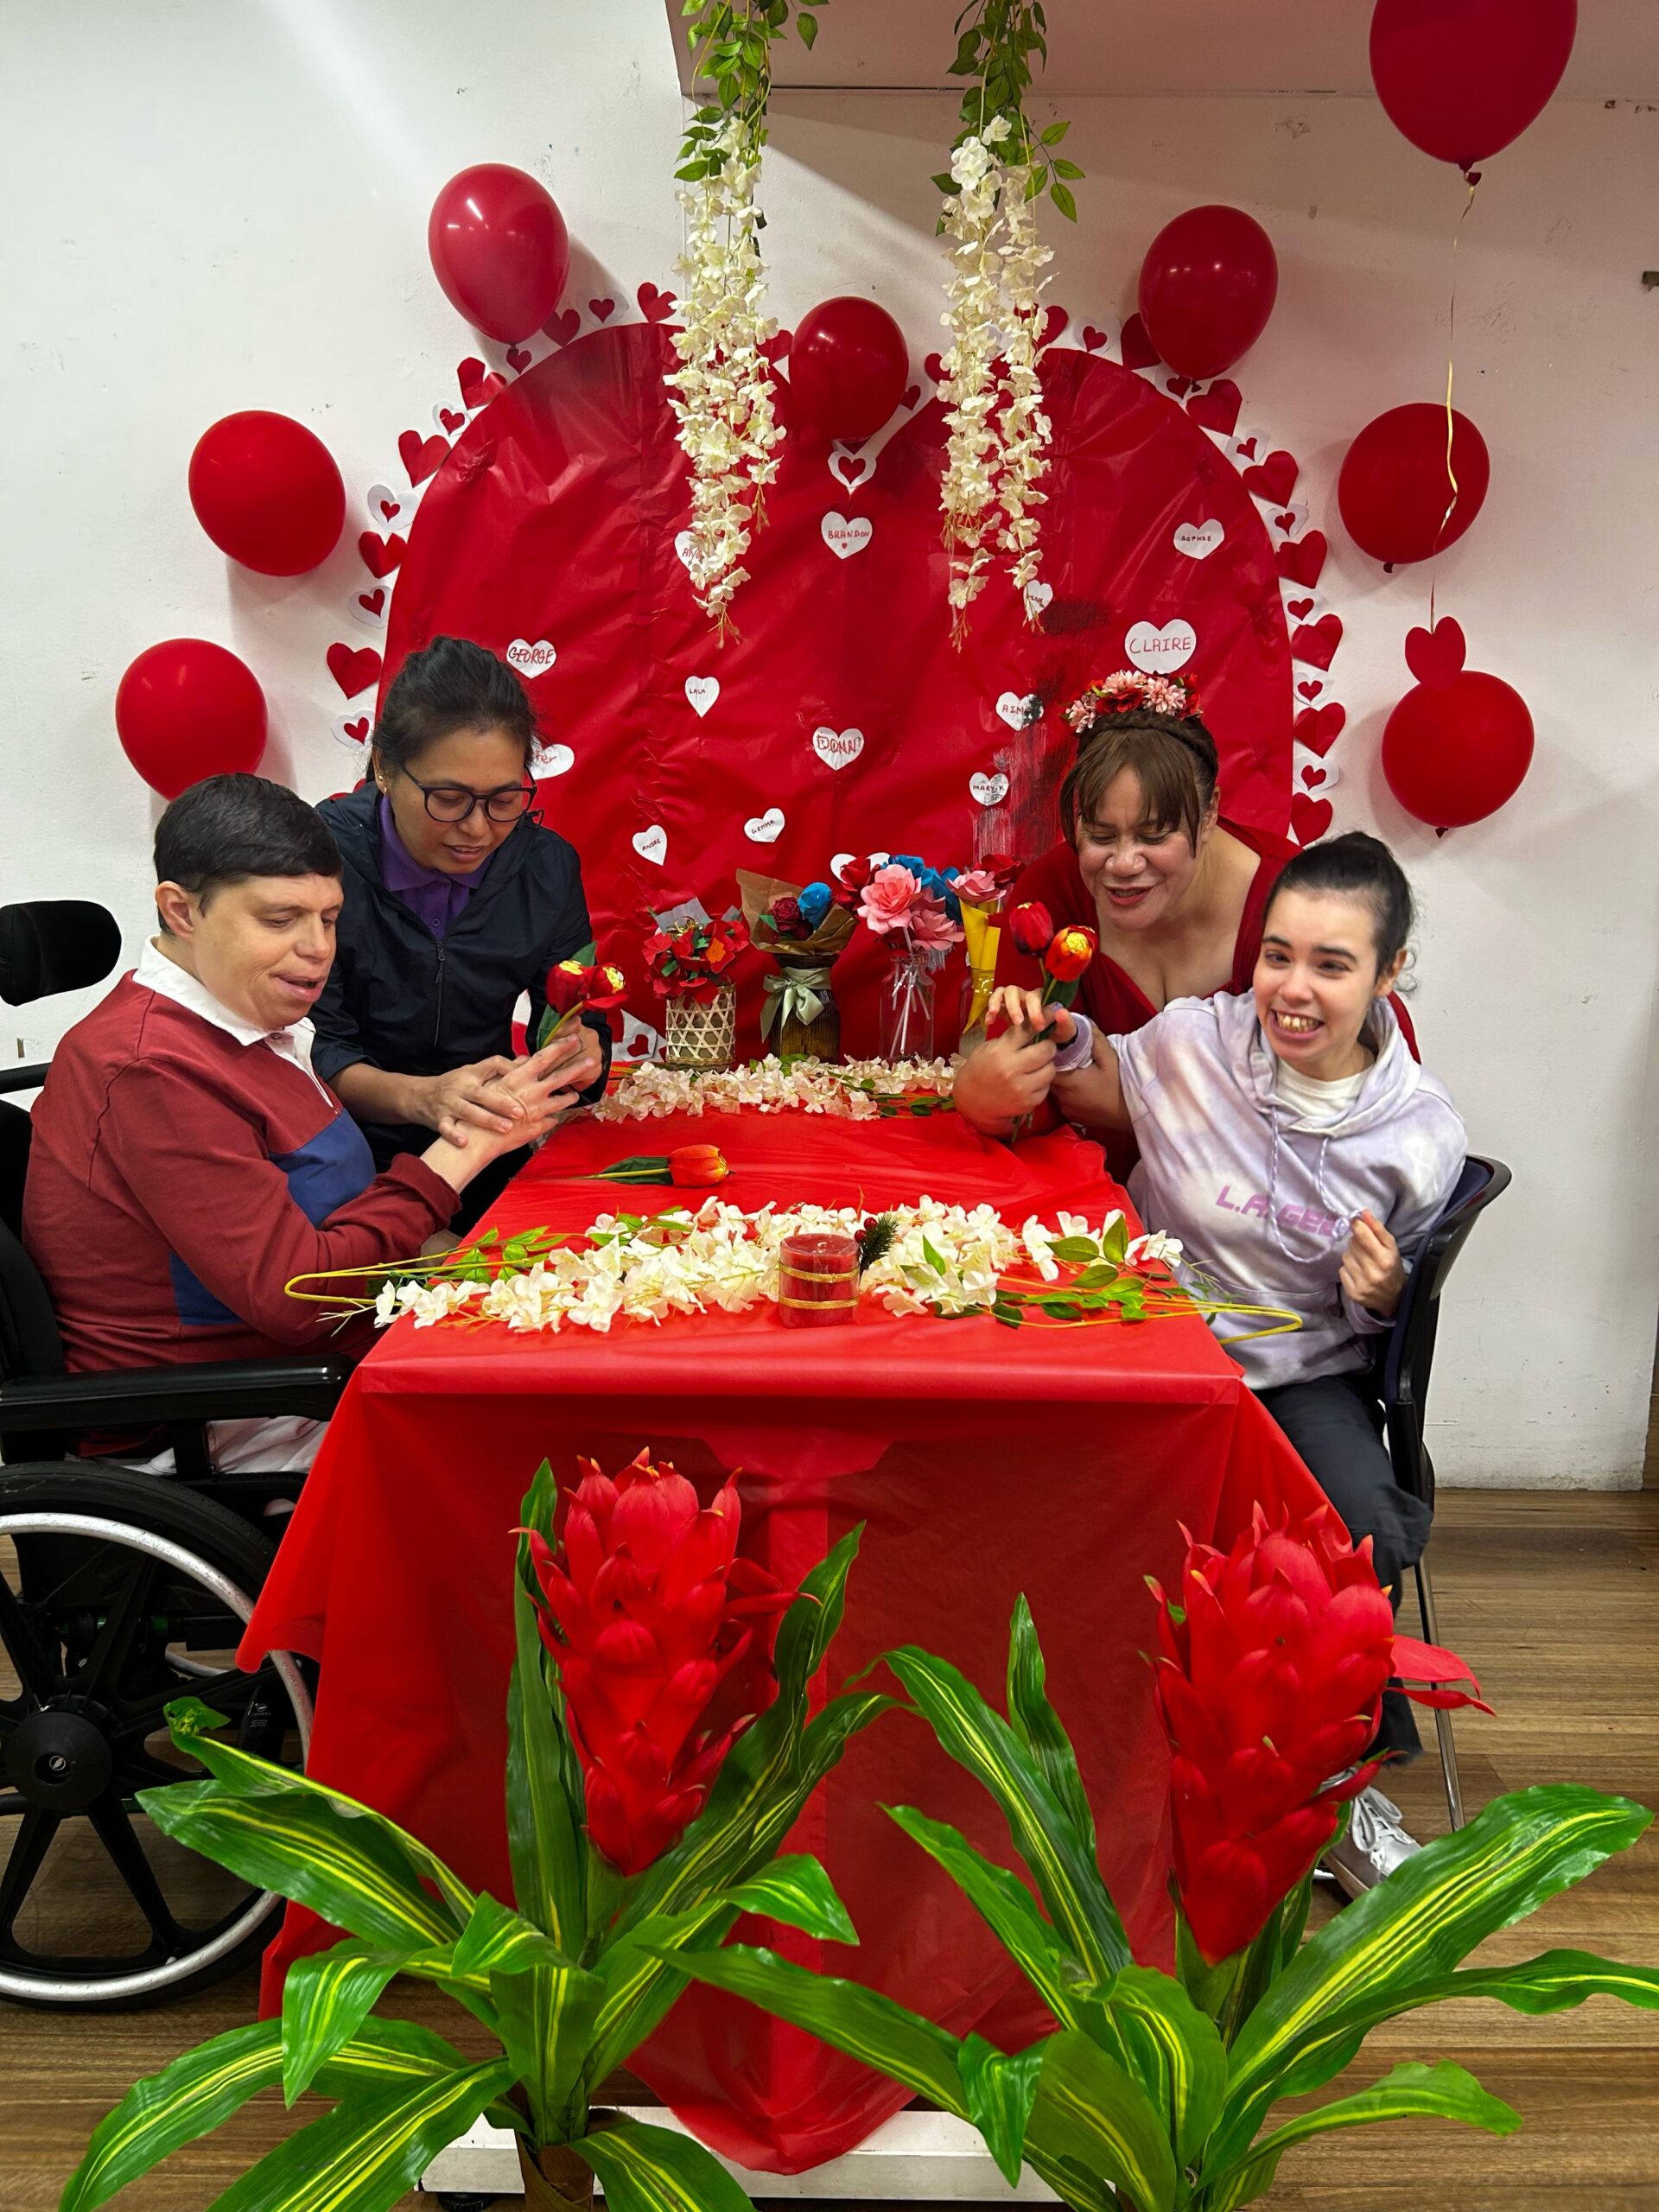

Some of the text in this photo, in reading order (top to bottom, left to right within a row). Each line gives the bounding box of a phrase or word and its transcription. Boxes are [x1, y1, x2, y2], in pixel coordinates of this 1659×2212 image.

[828, 530, 869, 539] BRANDON
[1129, 637, 1192, 654] CLAIRE
[508, 646, 554, 664] GEORGE
[751, 819, 775, 835] GEMMA
